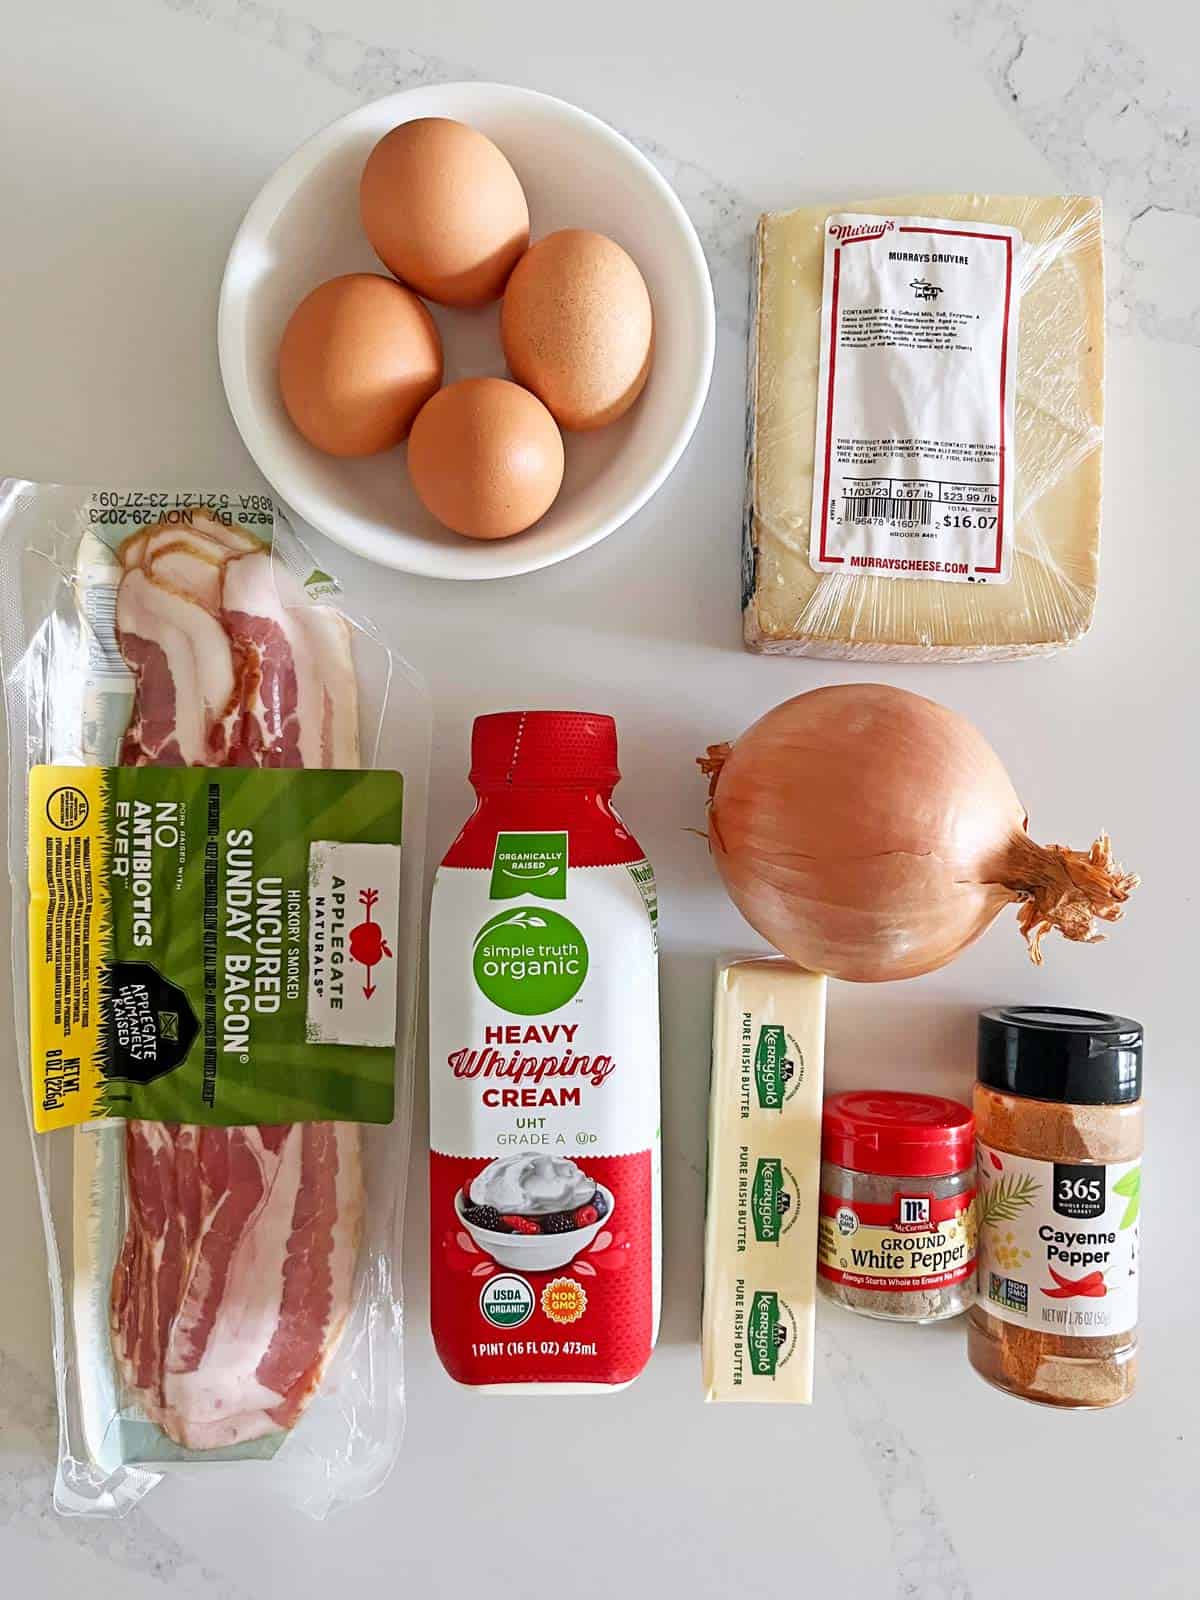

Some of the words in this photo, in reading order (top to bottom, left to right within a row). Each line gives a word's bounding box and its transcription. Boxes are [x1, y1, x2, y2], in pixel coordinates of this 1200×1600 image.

[828, 220, 895, 246] Murray's
[888, 251, 930, 263] MURRAYS
[100, 492, 169, 508] 23-27-09
[842, 487, 889, 497] 11/03/23
[896, 489, 920, 498] 0.67
[923, 489, 934, 499] lb
[89, 508, 193, 525] NOV-29-2023
[943, 513, 998, 530] $16.07
[850, 556, 969, 574] MURRAYSCHEESE.COM
[155, 802, 178, 848] NO
[498, 852, 562, 861] ORGANICALLY
[511, 861, 546, 870] RAISED
[133, 800, 152, 946] ANTIBIOTICS
[175, 867, 184, 890] WITH
[226, 829, 253, 944] SUNDAY
[288, 889, 301, 941] HICKORY
[254, 877, 282, 1013] UNCURED
[330, 876, 346, 1010] APPLEGATE
[483, 944, 535, 958] simple
[539, 944, 579, 956] truth
[286, 947, 300, 1000] SMOKED
[483, 957, 580, 980] organic
[119, 986, 143, 1060] HUMANELY
[130, 984, 157, 1060] APPLEGATE
[741, 1012, 751, 1040] PURE
[485, 1024, 579, 1044] HEAVY
[46, 1059, 63, 1076] OZ.
[64, 1058, 81, 1076] NET
[447, 1048, 616, 1086] Whipping
[741, 1042, 751, 1073] IRISH
[762, 1028, 781, 1105] Kerrygold
[43, 1076, 65, 1111] (226g)
[63, 1078, 80, 1096] WT.
[481, 1087, 582, 1107] CREAM
[740, 1076, 750, 1119] BUTTER
[515, 1117, 547, 1129] UHT
[496, 1133, 549, 1145] GRADE
[555, 1134, 566, 1145] A
[739, 1146, 749, 1174] PURE
[737, 1176, 748, 1207] IRISH
[758, 1162, 777, 1238] Kerrygold
[1058, 1177, 1101, 1201] 365
[736, 1210, 746, 1252] BUTTER
[881, 1234, 946, 1250] GROUND
[1038, 1225, 1116, 1247] Cayenne
[851, 1248, 905, 1269] White
[910, 1244, 965, 1272] Pepper
[1047, 1245, 1110, 1267] Pepper
[865, 1276, 887, 1286] Starts
[1007, 1280, 1026, 1291] NON
[493, 1290, 521, 1301] USDA
[551, 1292, 577, 1300] NON
[735, 1279, 745, 1307] PURE
[489, 1303, 525, 1314] ORGANIC
[551, 1301, 577, 1310] GMO
[734, 1309, 744, 1341] IRISH
[754, 1295, 774, 1372] Kerrygold
[472, 1344, 478, 1357] 1
[479, 1343, 504, 1356] PINT
[507, 1342, 524, 1356] (16
[526, 1342, 538, 1355] FL
[540, 1341, 560, 1356] OZ)
[562, 1341, 598, 1356] 473mL
[732, 1343, 742, 1385] BUTTER
